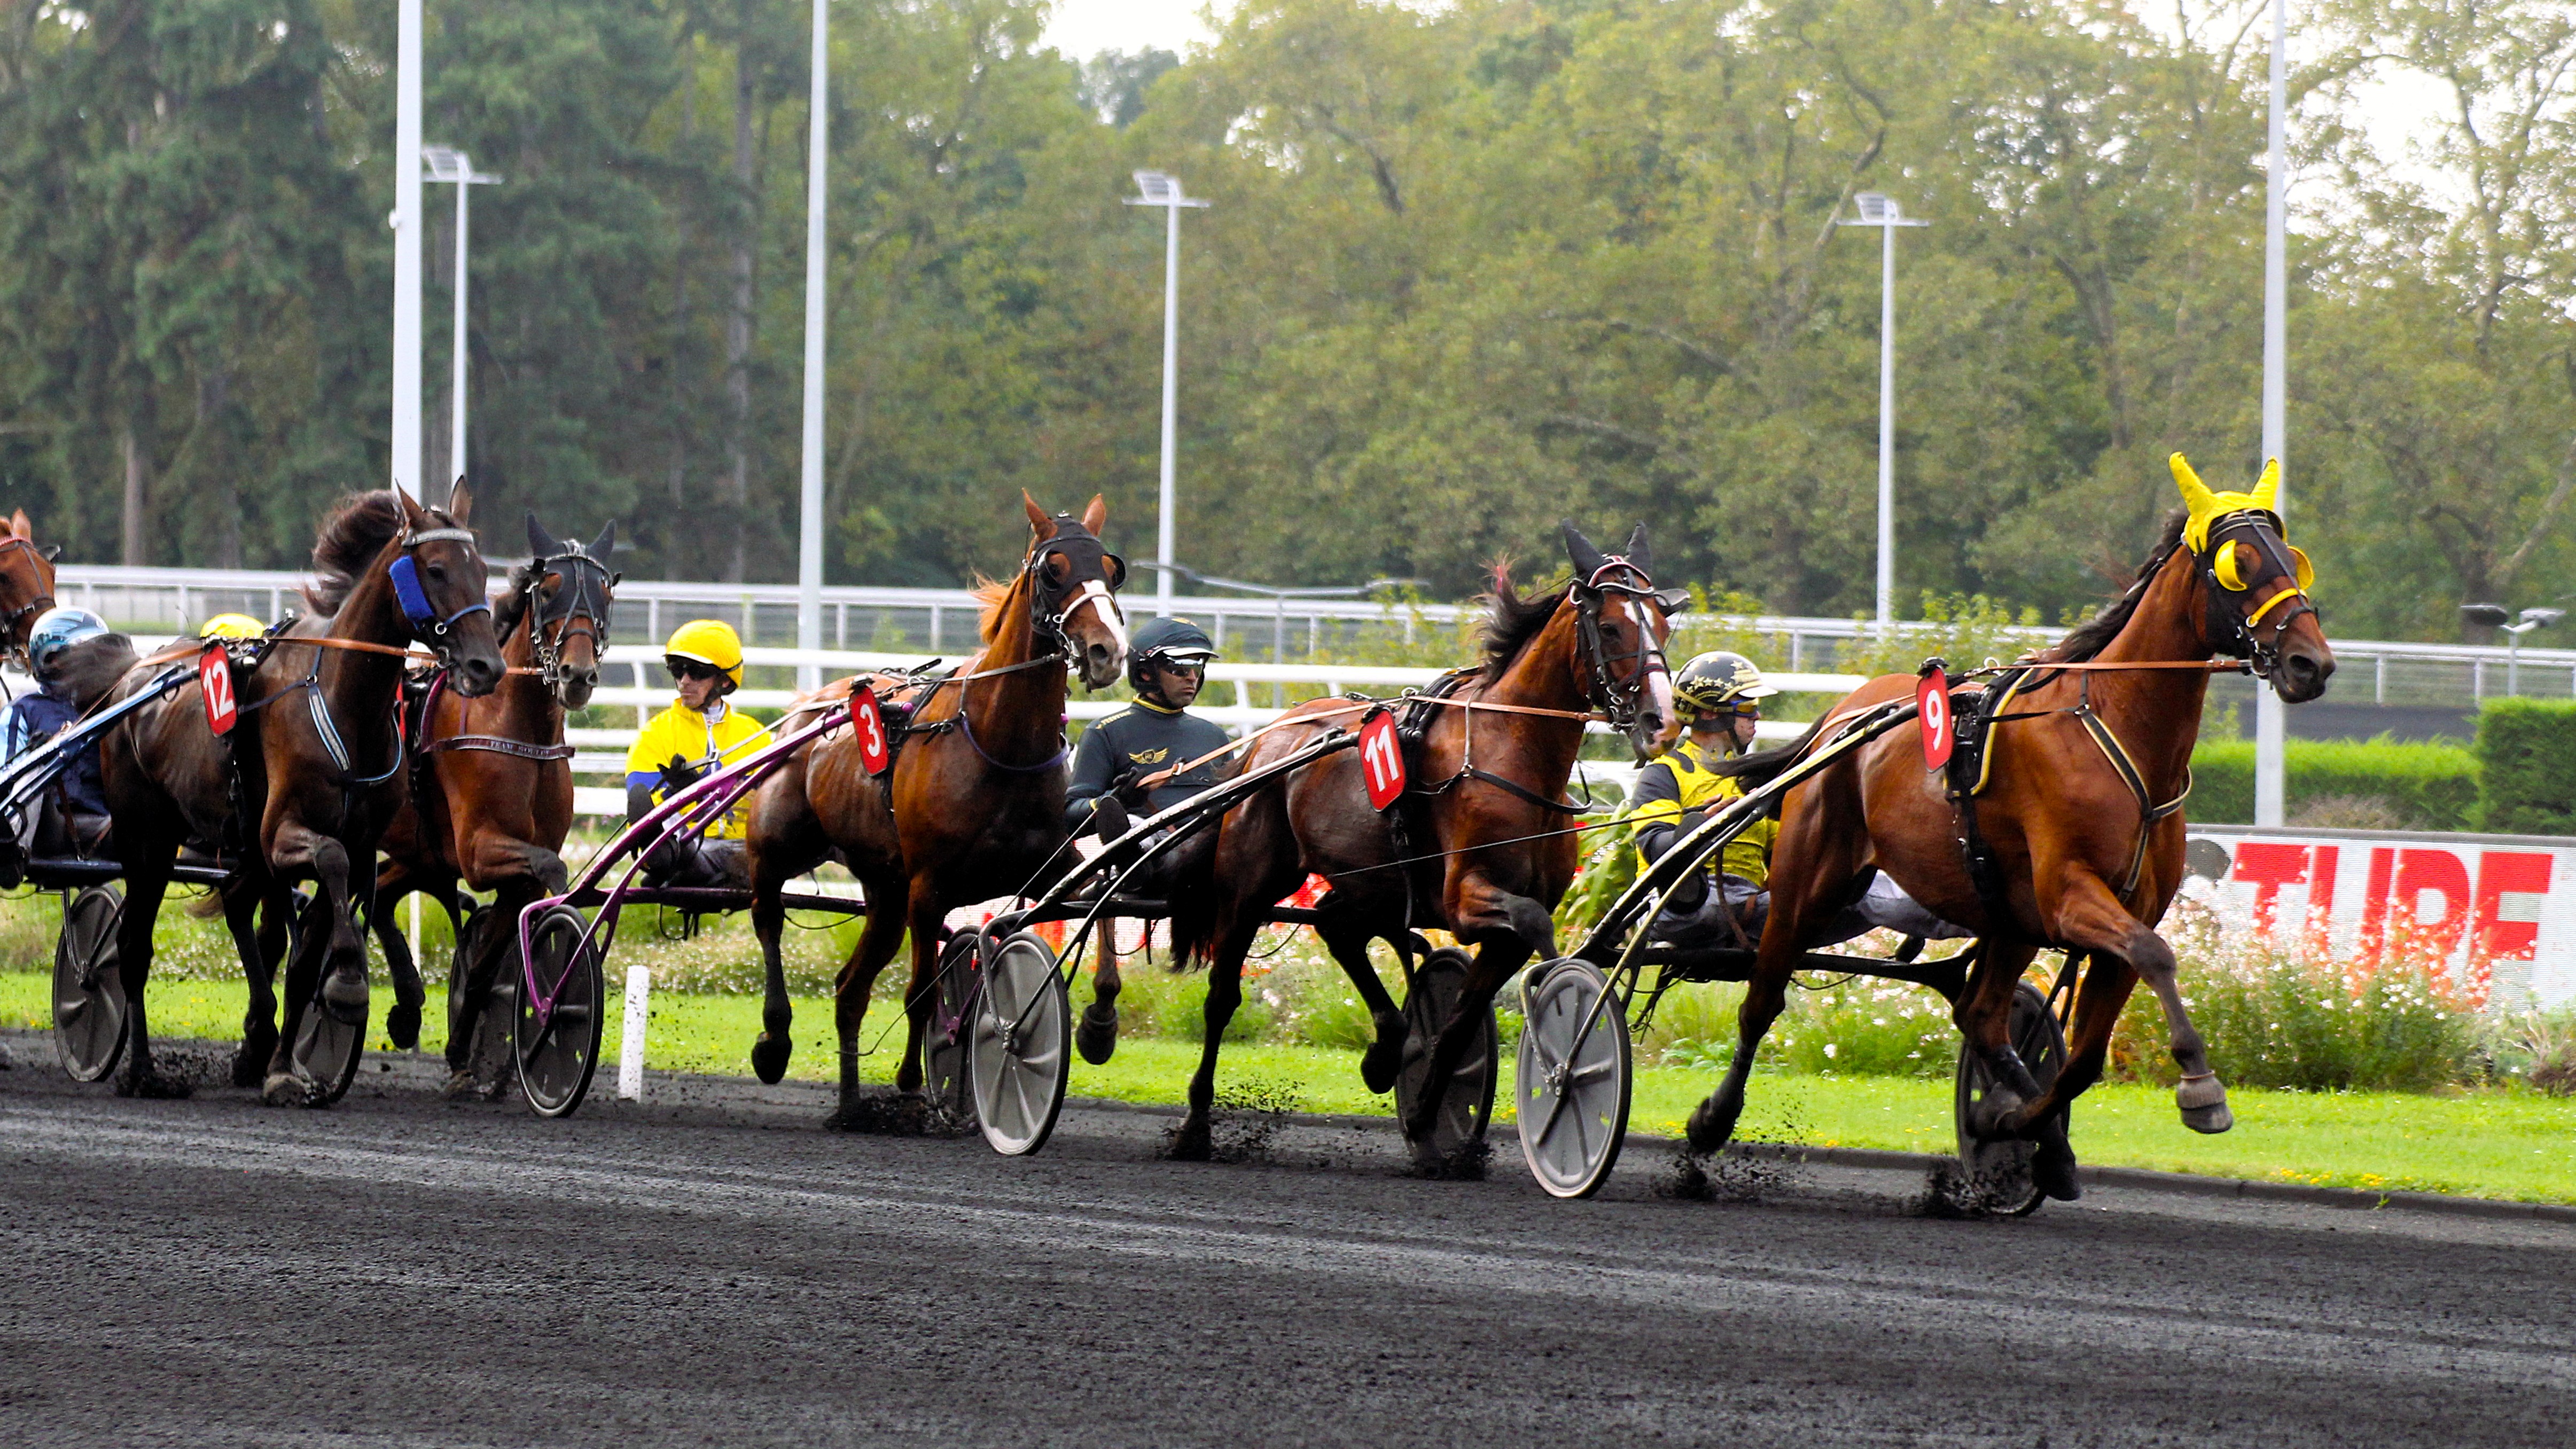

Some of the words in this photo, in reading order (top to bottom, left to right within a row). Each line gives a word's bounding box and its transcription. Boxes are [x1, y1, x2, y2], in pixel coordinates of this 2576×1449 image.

[203, 660, 235, 721] 12
[1925, 690, 1943, 751] 9
[860, 703, 880, 757] 3
[1364, 724, 1399, 793] 11
[2234, 842, 2554, 1011] TURF
